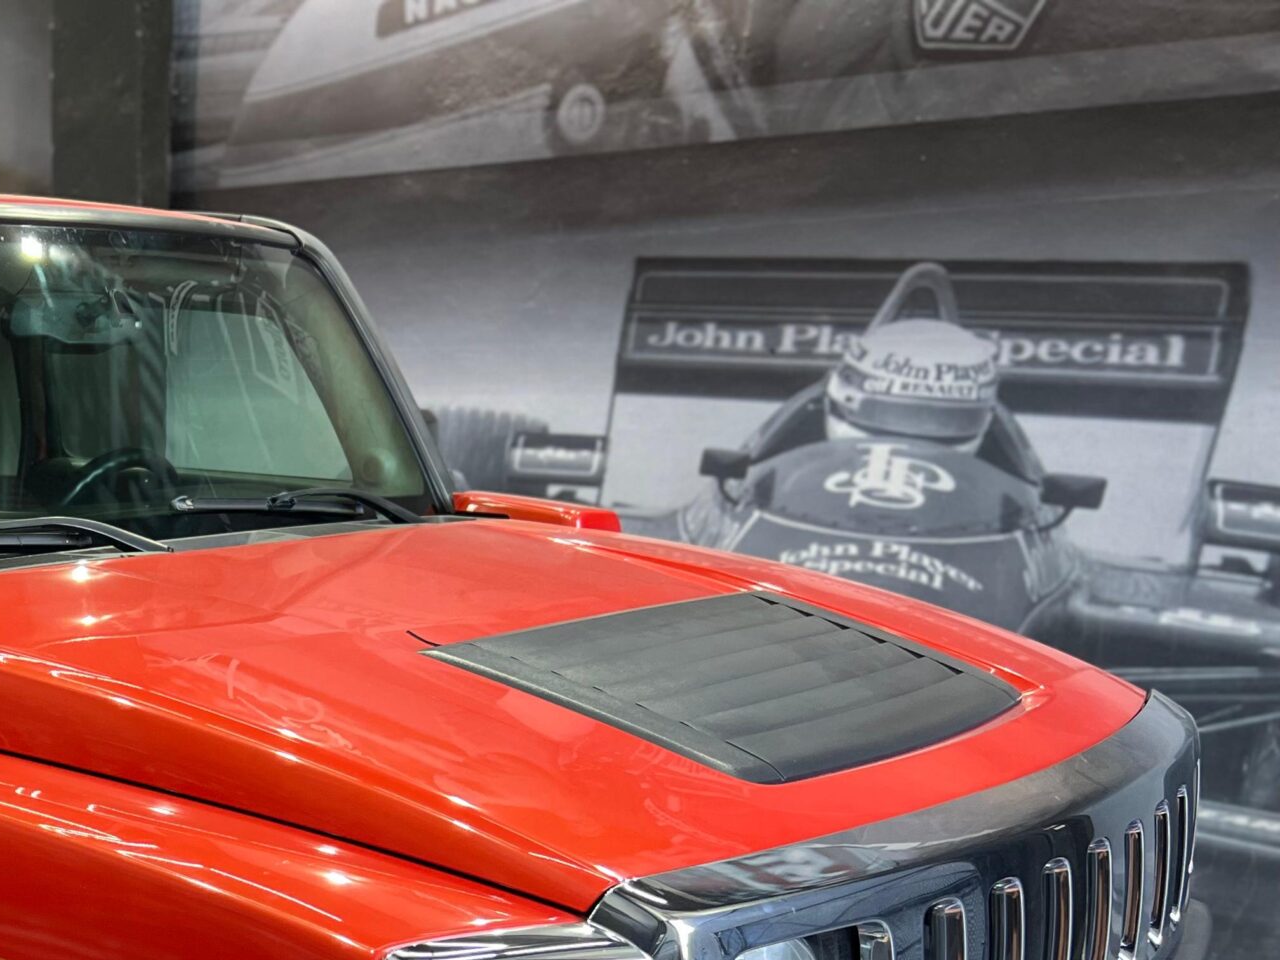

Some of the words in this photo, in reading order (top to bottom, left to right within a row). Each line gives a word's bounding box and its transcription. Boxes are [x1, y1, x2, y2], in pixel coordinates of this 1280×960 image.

[647, 320, 765, 351] John
[992, 331, 1185, 367] pecial
[871, 540, 984, 592] Player
